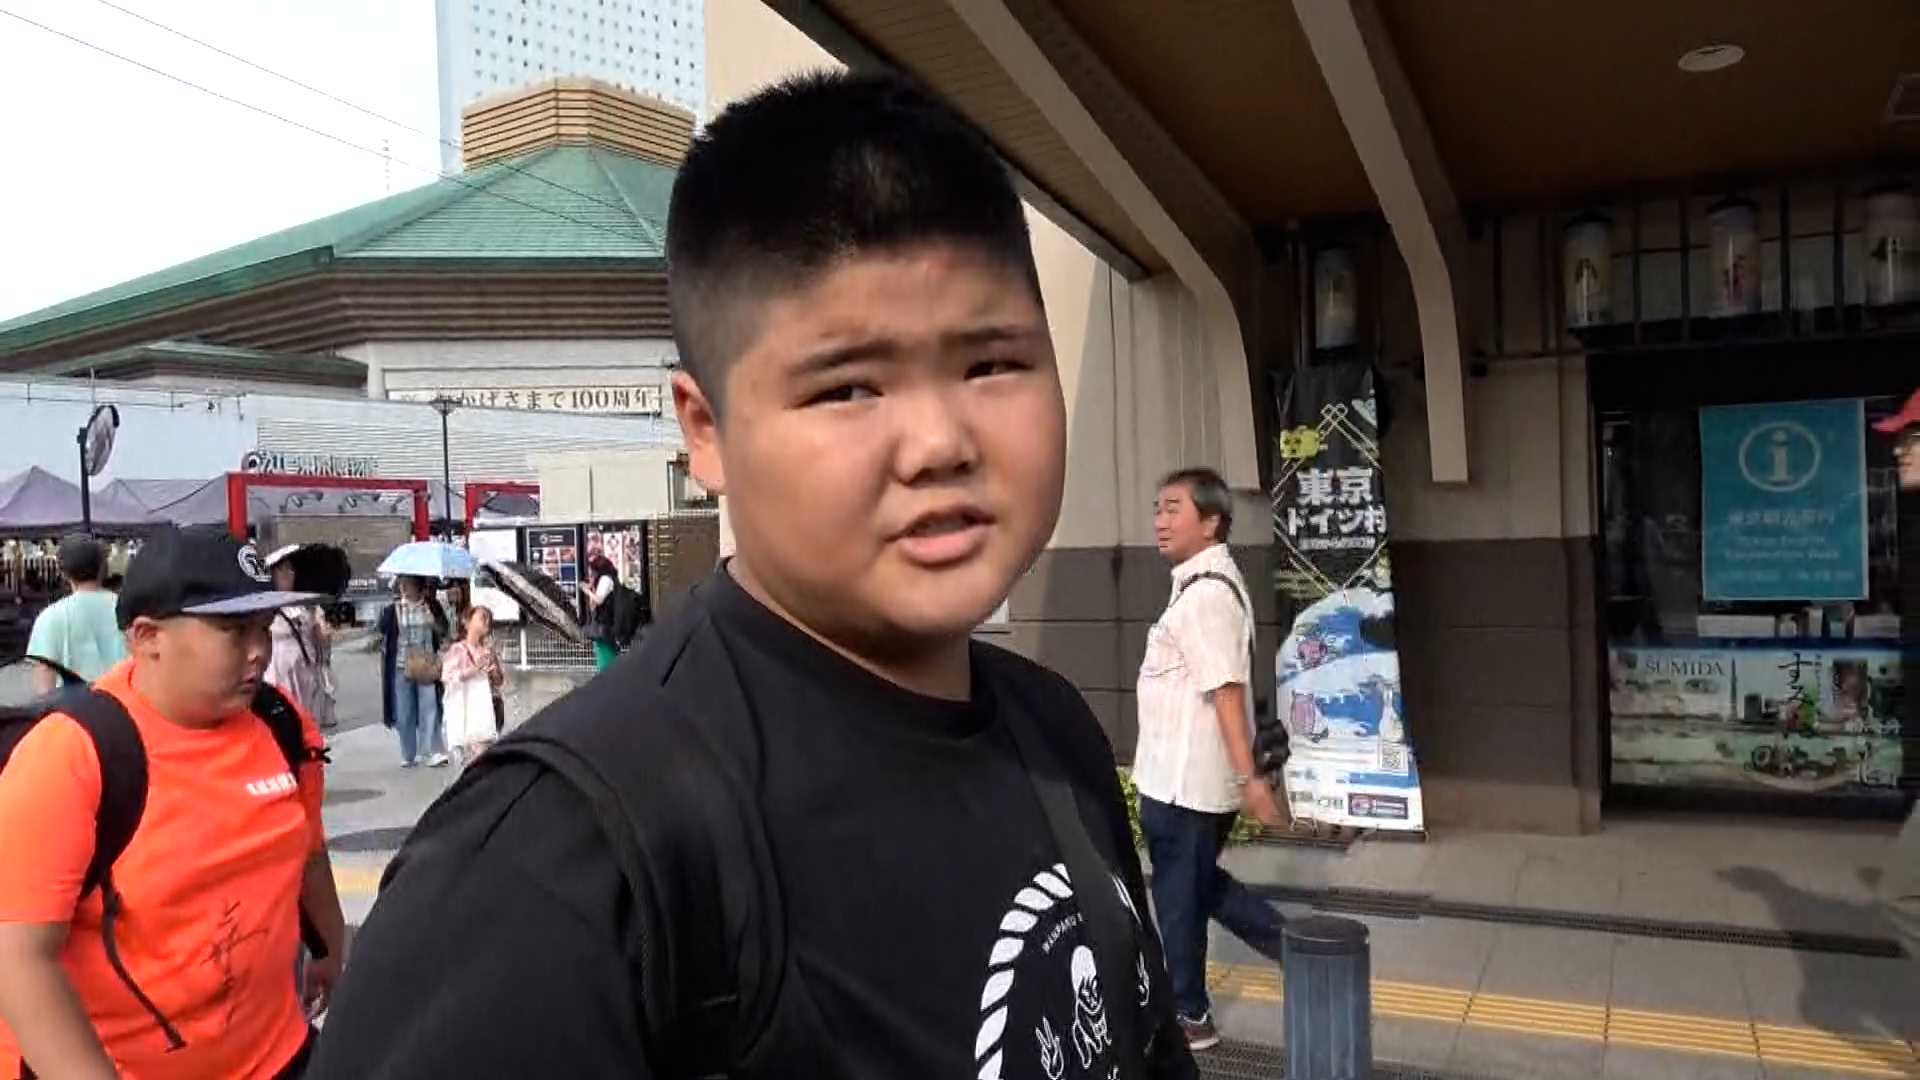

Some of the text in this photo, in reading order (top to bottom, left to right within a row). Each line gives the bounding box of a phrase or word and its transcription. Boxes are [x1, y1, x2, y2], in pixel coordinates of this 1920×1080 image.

[1296, 468, 1373, 506] 東京
[1287, 505, 1387, 536] ドイツ村
[1645, 660, 1726, 676] SUMIDA
